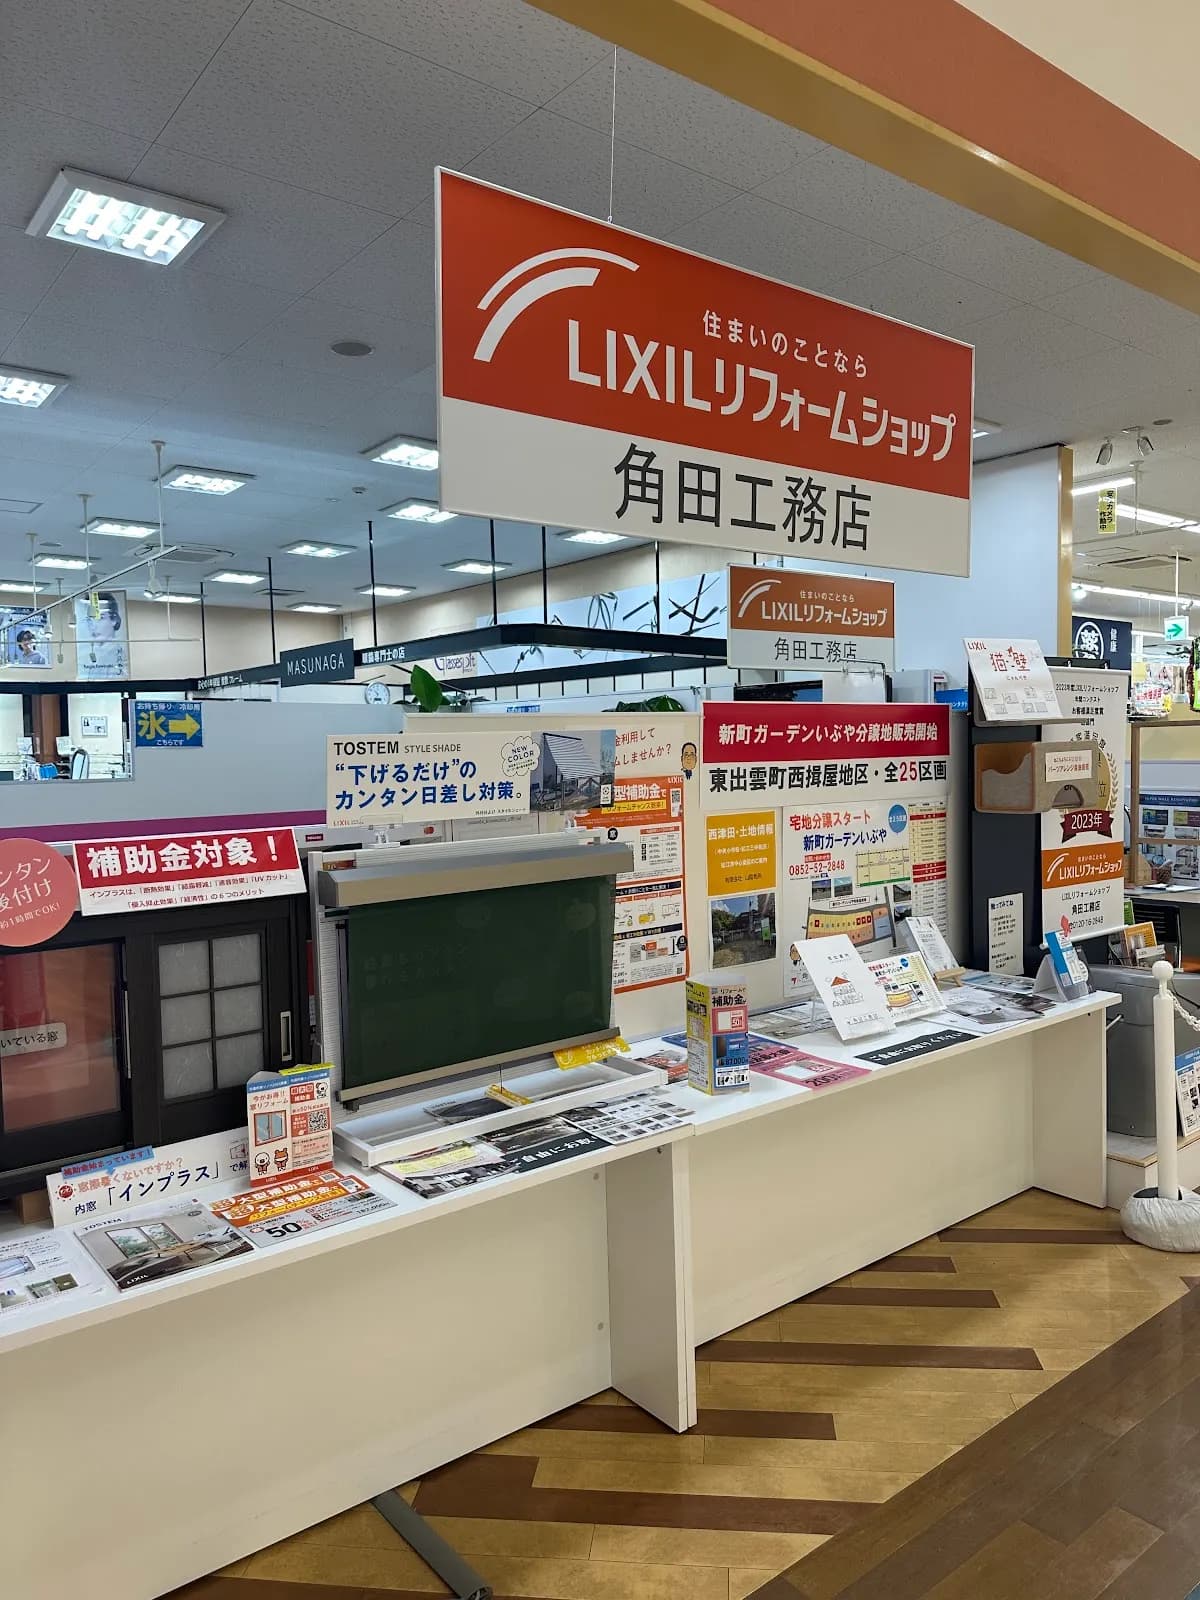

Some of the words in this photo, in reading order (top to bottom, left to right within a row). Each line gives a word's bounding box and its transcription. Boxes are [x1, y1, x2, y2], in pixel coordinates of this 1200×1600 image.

[702, 309, 868, 378] 住まいのことなら
[568, 319, 956, 462] LIXILリフォームショップ
[614, 442, 872, 551] 角田工務店
[799, 590, 855, 603] 住まいのことなら
[761, 600, 888, 627] LIXILリフォームショップ
[774, 637, 857, 663] 角田工務店
[967, 641, 987, 651] LIXIL
[287, 652, 345, 676] MASUNAGA
[138, 711, 168, 740] 氷
[718, 722, 938, 745] 新町ガーデンいぶや分譲地販売開始
[333, 741, 399, 756] TOSTEM
[404, 744, 431, 754] STYLE
[432, 743, 462, 753] SHADE
[507, 751, 534, 763] COLOR
[511, 744, 528, 754] NEW
[667, 776, 683, 784] LIXIL
[708, 760, 947, 792] 東出雲町西揖屋地区・全25区画
[335, 780, 522, 810] カンタン日差し対策。
[789, 808, 871, 831] 宅地分譲スタート
[1071, 812, 1103, 830] 2023年
[708, 824, 773, 840] 西津田・土地情報
[803, 828, 887, 852] 新町ガーデンいぶや
[86, 835, 278, 878] 補助金対象！
[1077, 853, 1107, 863] 住まいのことなら
[788, 860, 845, 876] 0852-52-2848
[1059, 859, 1122, 880] LIXILリフォームショップ
[1061, 885, 1111, 901] LIXILリフォームショップ
[1071, 901, 1101, 916] 角田工務店
[74, 1201, 97, 1216] 内窓
[107, 1161, 220, 1206] 「インプラス」
[83, 1217, 122, 1231] TOSTEM
[265, 1222, 303, 1238] 50
[126, 1273, 149, 1285] LIXIL
